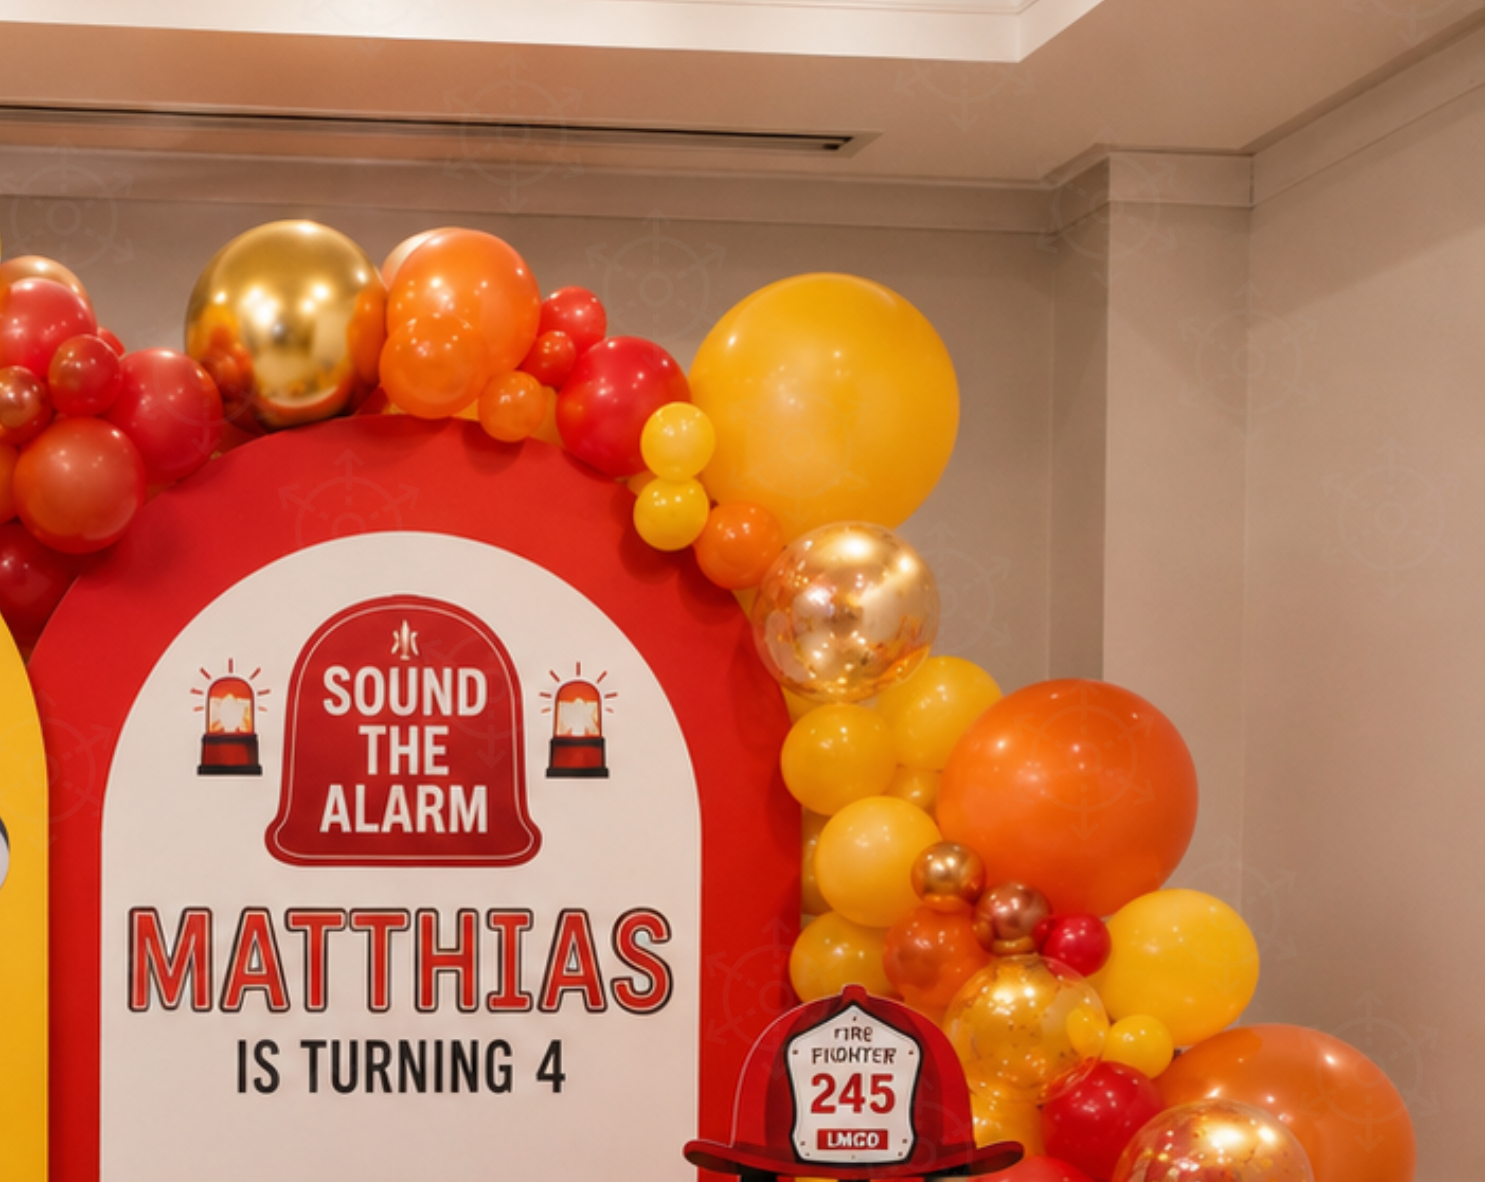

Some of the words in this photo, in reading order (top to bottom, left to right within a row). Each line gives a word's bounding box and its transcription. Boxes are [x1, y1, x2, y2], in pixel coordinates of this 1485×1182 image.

[323, 665, 487, 716] SOUND
[358, 725, 449, 776] THE
[319, 784, 487, 833] ALARM
[127, 906, 674, 1016] MATTHIAS
[237, 1039, 280, 1094] IS
[300, 1038, 513, 1094] TURNING
[536, 1039, 566, 1094] 4
[810, 1072, 896, 1115] 245
